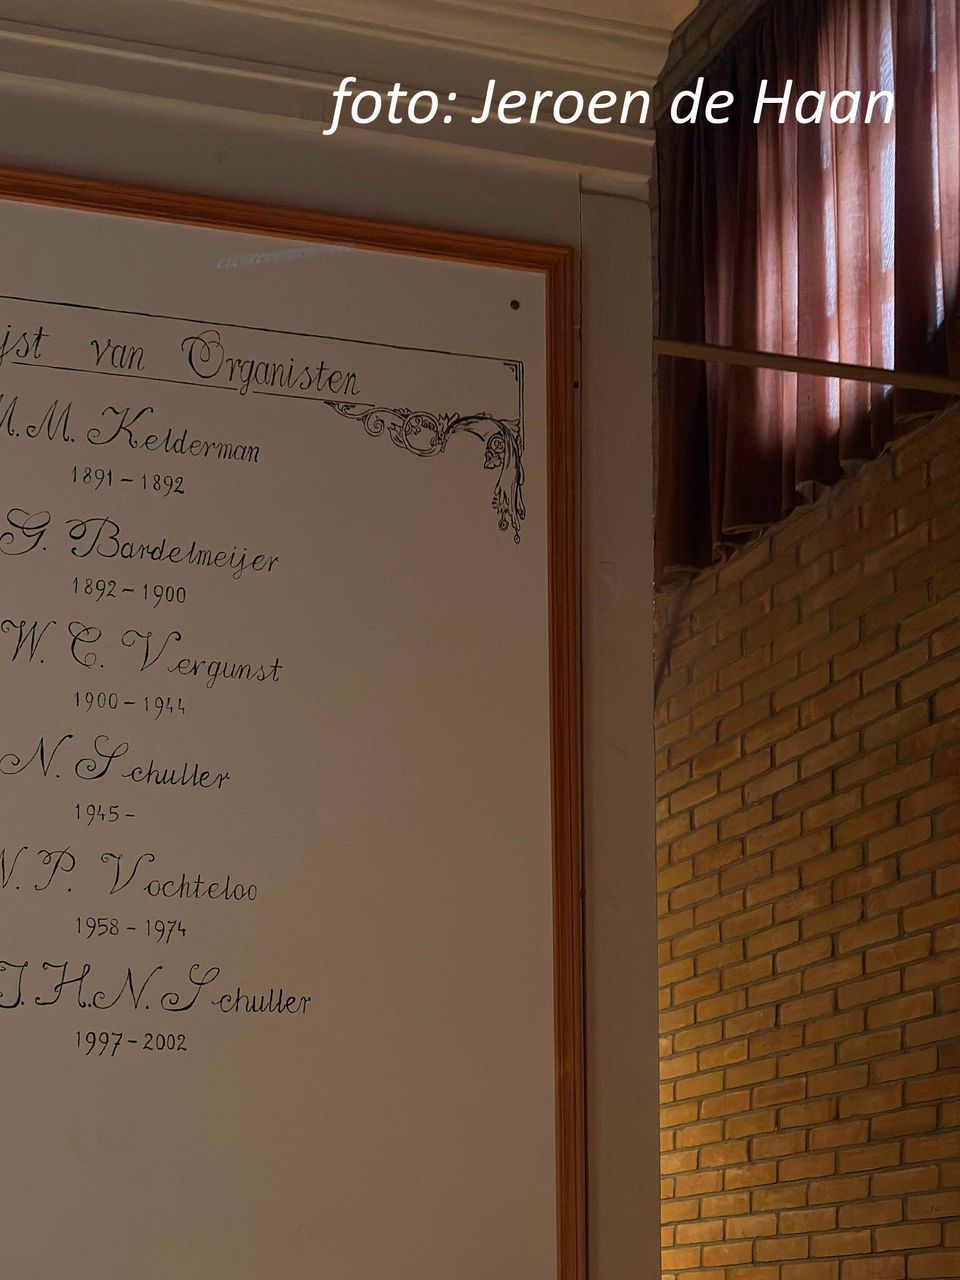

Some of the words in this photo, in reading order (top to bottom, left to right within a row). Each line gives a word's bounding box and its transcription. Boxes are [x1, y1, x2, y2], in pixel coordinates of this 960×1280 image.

[90, 338, 144, 371] van
[180, 329, 361, 397] Organisten
[86, 406, 260, 463] Kelderman
[64, 516, 279, 581] Bardelmeijer
[120, 629, 283, 690] Vergunst
[74, 734, 231, 790] Schuller
[100, 852, 258, 901] Vochteloo
[160, 963, 312, 1014] Schuller
